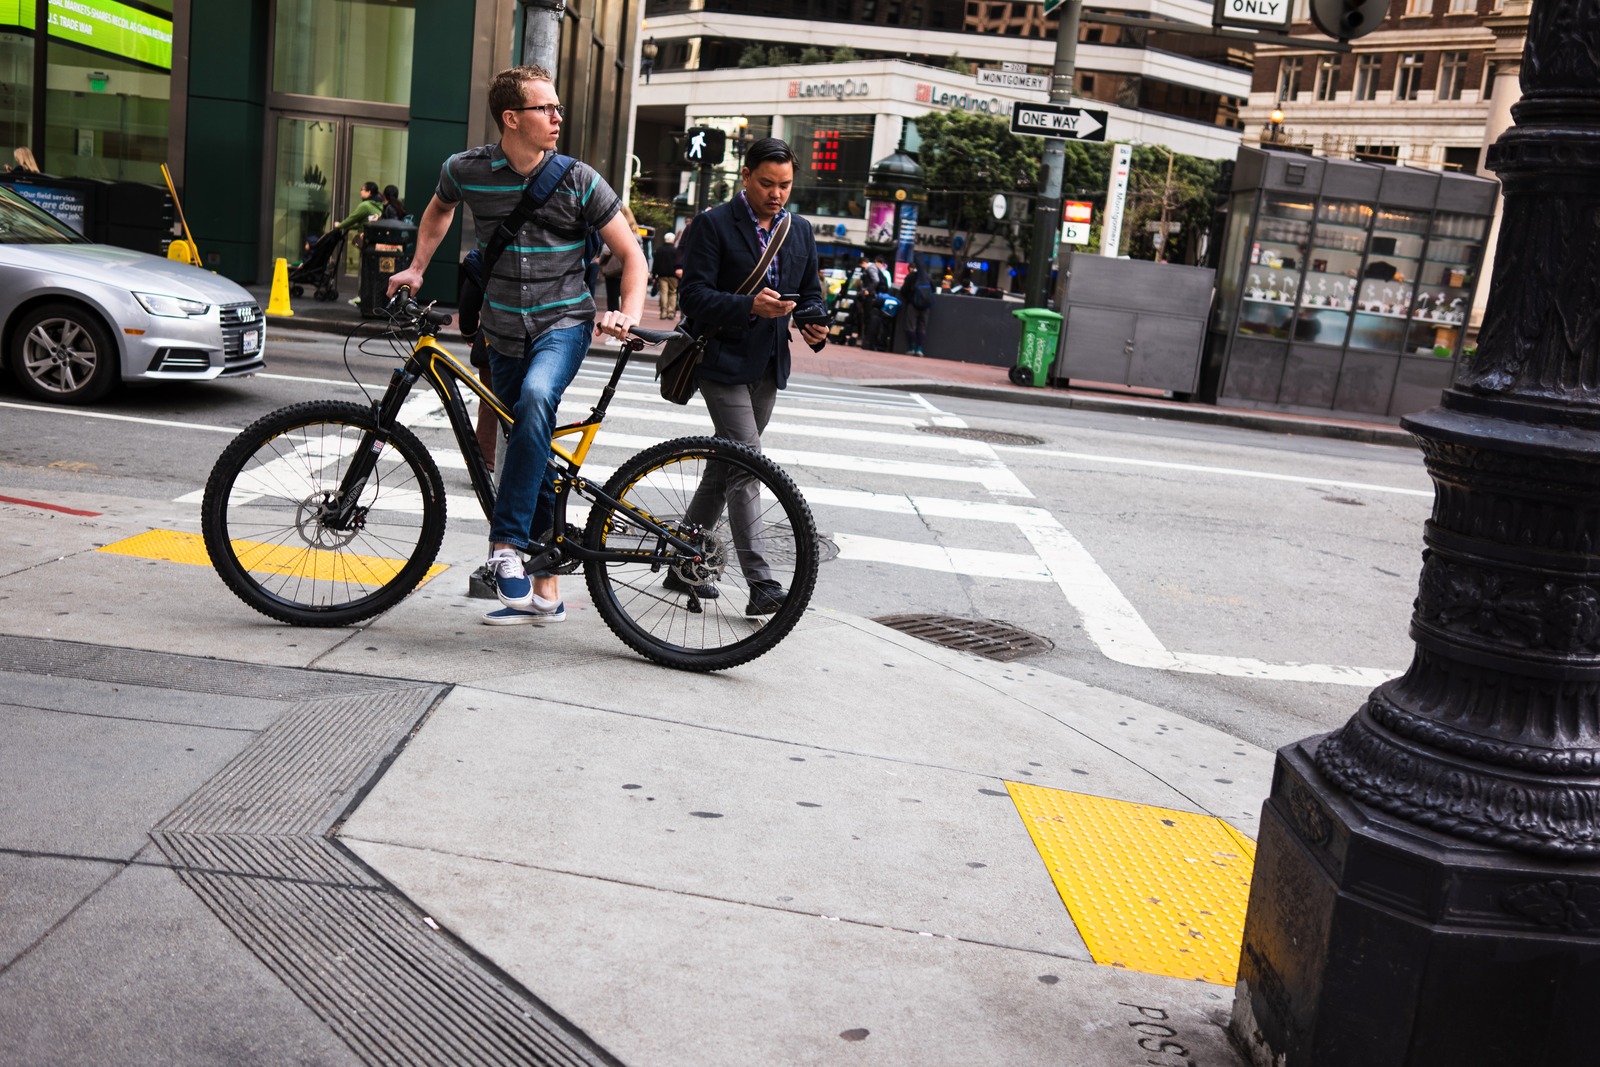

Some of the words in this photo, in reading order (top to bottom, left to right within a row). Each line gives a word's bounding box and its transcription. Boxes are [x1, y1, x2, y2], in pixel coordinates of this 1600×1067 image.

[1233, 0, 1279, 15] ONLY
[59, 15, 79, 31] TRADE
[79, 21, 93, 36] WAR
[983, 72, 1044, 88] MONTGOMERY
[798, 79, 868, 101] LendingClub
[1022, 112, 1048, 127] ONE
[1053, 115, 1079, 130] WAY
[42, 201, 58, 210] are
[58, 201, 84, 212] down
[52, 194, 76, 202] service
[1107, 192, 1124, 248] Montgomery
